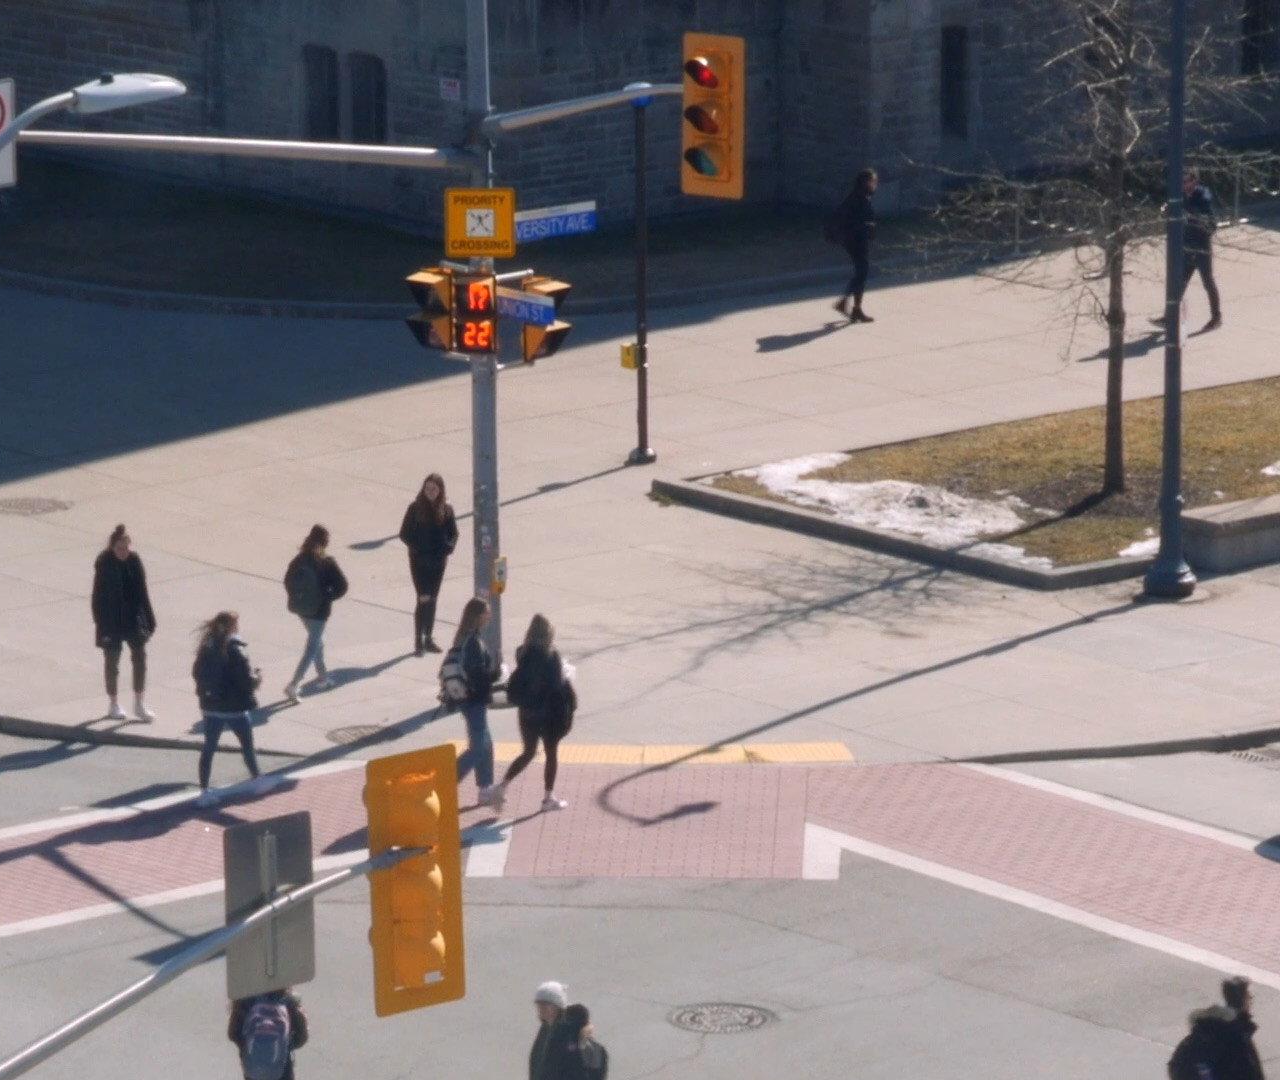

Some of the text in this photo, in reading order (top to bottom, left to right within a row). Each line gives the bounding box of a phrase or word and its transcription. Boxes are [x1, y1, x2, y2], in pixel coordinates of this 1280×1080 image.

[453, 195, 505, 205] PRIORITY
[515, 215, 567, 240] VERSITY
[451, 240, 510, 250] CROSSING
[464, 321, 492, 347] 22
